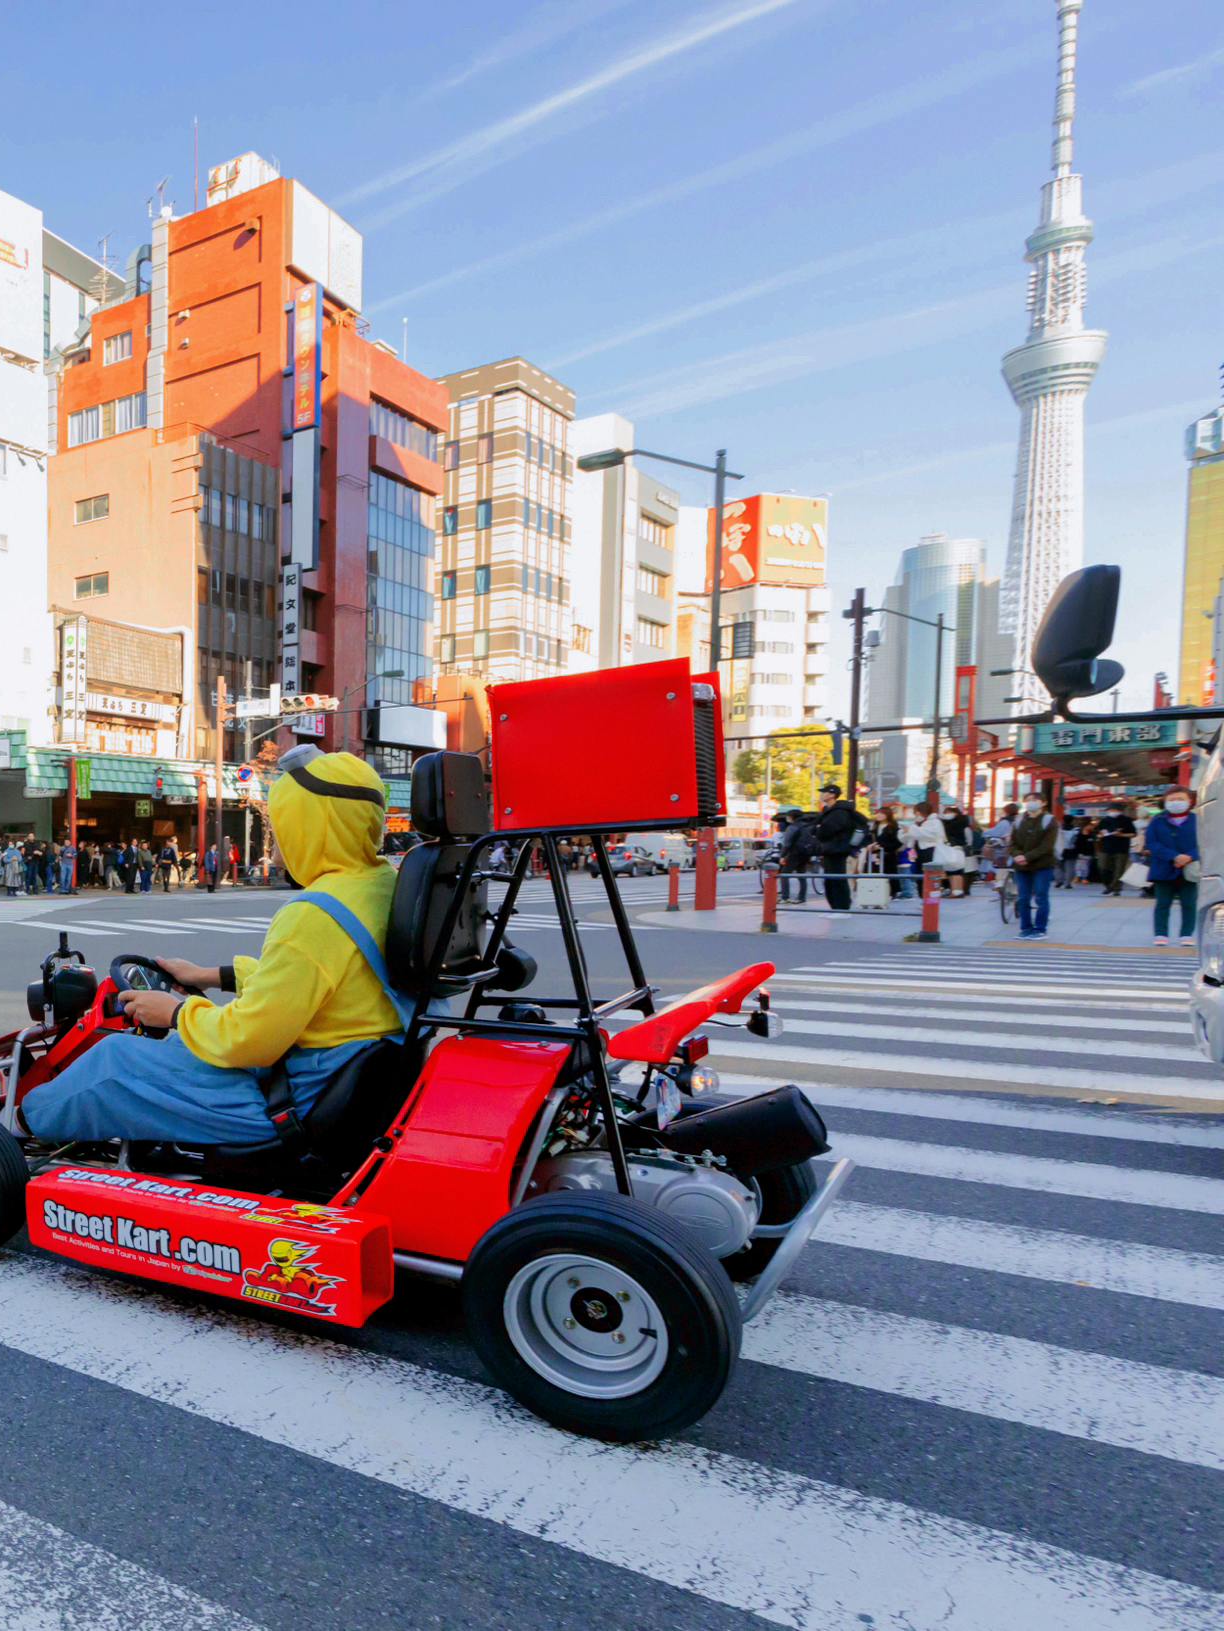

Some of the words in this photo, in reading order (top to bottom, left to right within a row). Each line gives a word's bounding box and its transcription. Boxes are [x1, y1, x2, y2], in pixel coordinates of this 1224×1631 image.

[1051, 724, 1162, 747] 雷門東部
[57, 1169, 136, 1188] Street
[133, 1179, 193, 1199] Kart
[188, 1192, 261, 1210] .com
[43, 1199, 114, 1244] Street
[117, 1216, 172, 1258] Kart
[174, 1237, 242, 1275] .com
[52, 1232, 68, 1243] Best
[68, 1236, 101, 1252] Activities
[101, 1245, 115, 1255] and
[116, 1248, 137, 1261] Tours
[138, 1255, 146, 1263] in
[147, 1256, 170, 1269] Japan
[171, 1262, 181, 1272] by
[245, 1286, 282, 1303] STREET
